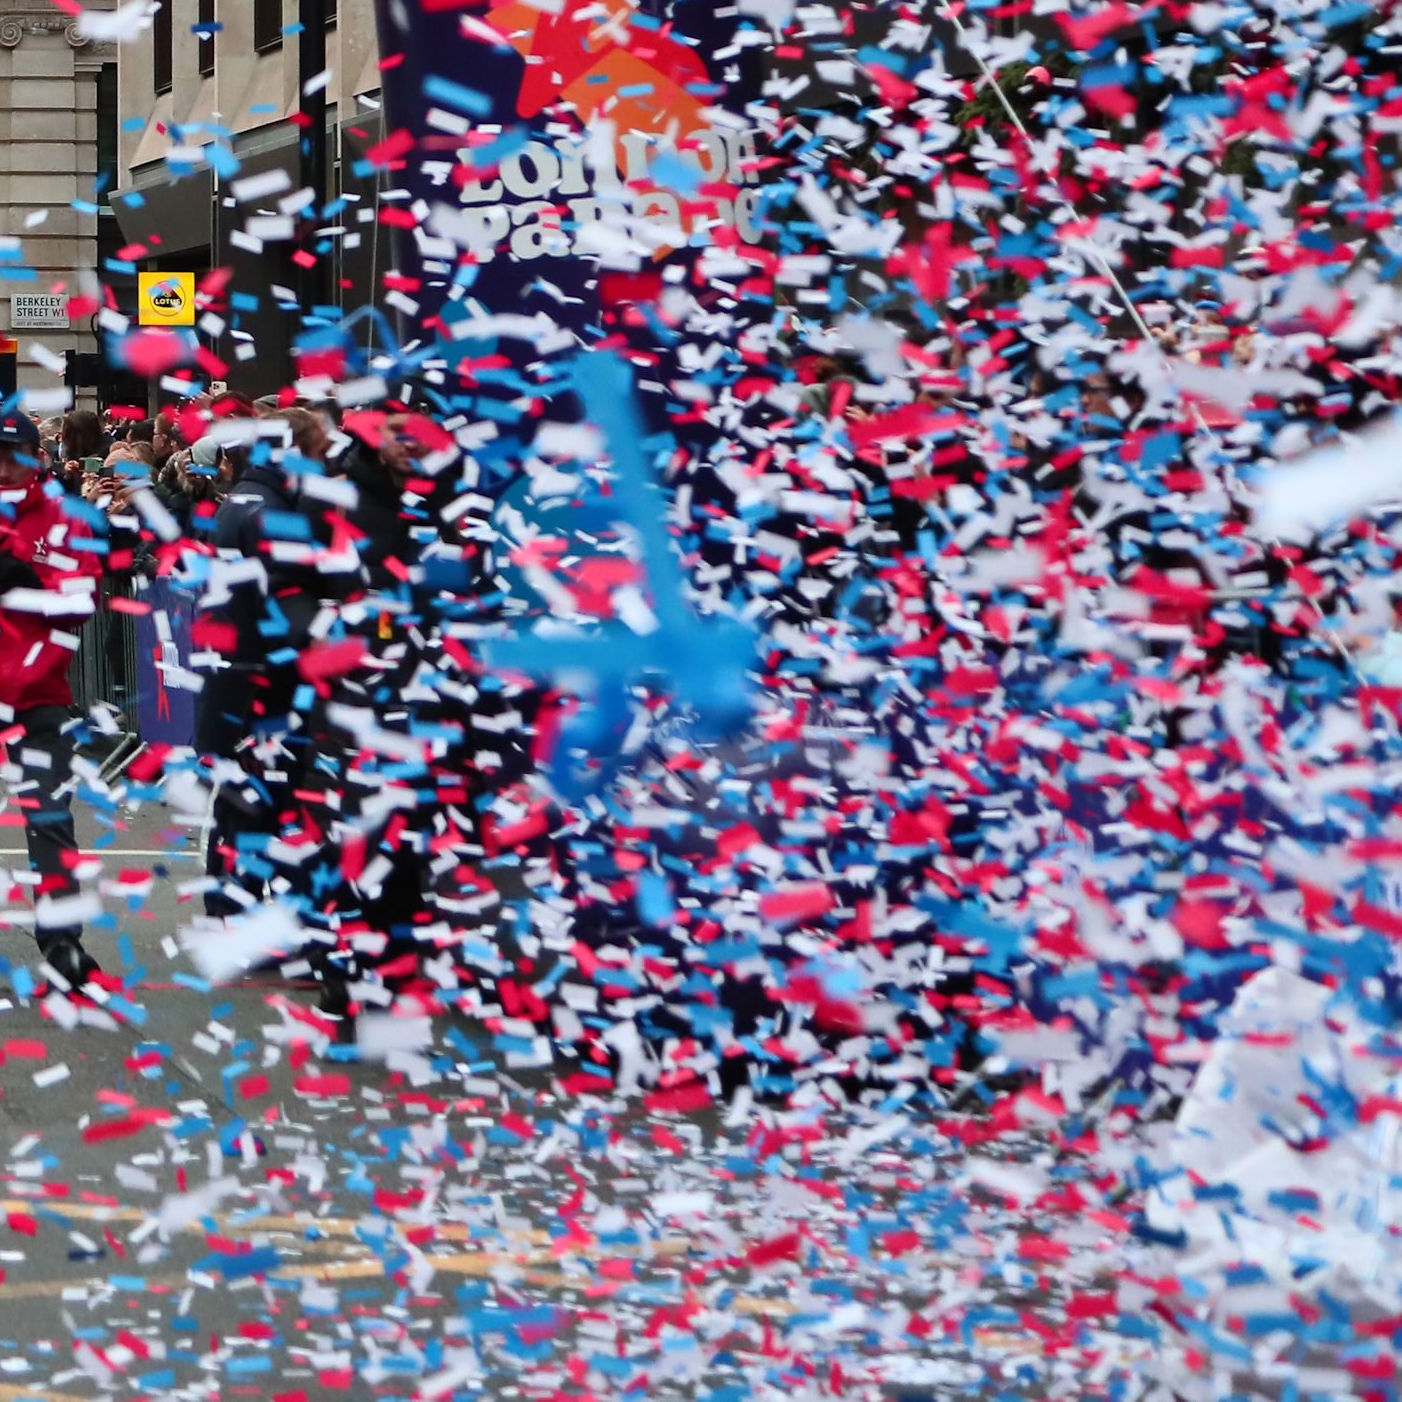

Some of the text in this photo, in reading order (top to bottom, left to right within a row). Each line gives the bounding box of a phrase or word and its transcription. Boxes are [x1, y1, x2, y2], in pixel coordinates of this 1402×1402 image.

[16, 297, 61, 306] BERKELEY
[16, 307, 64, 317] STREET W1
